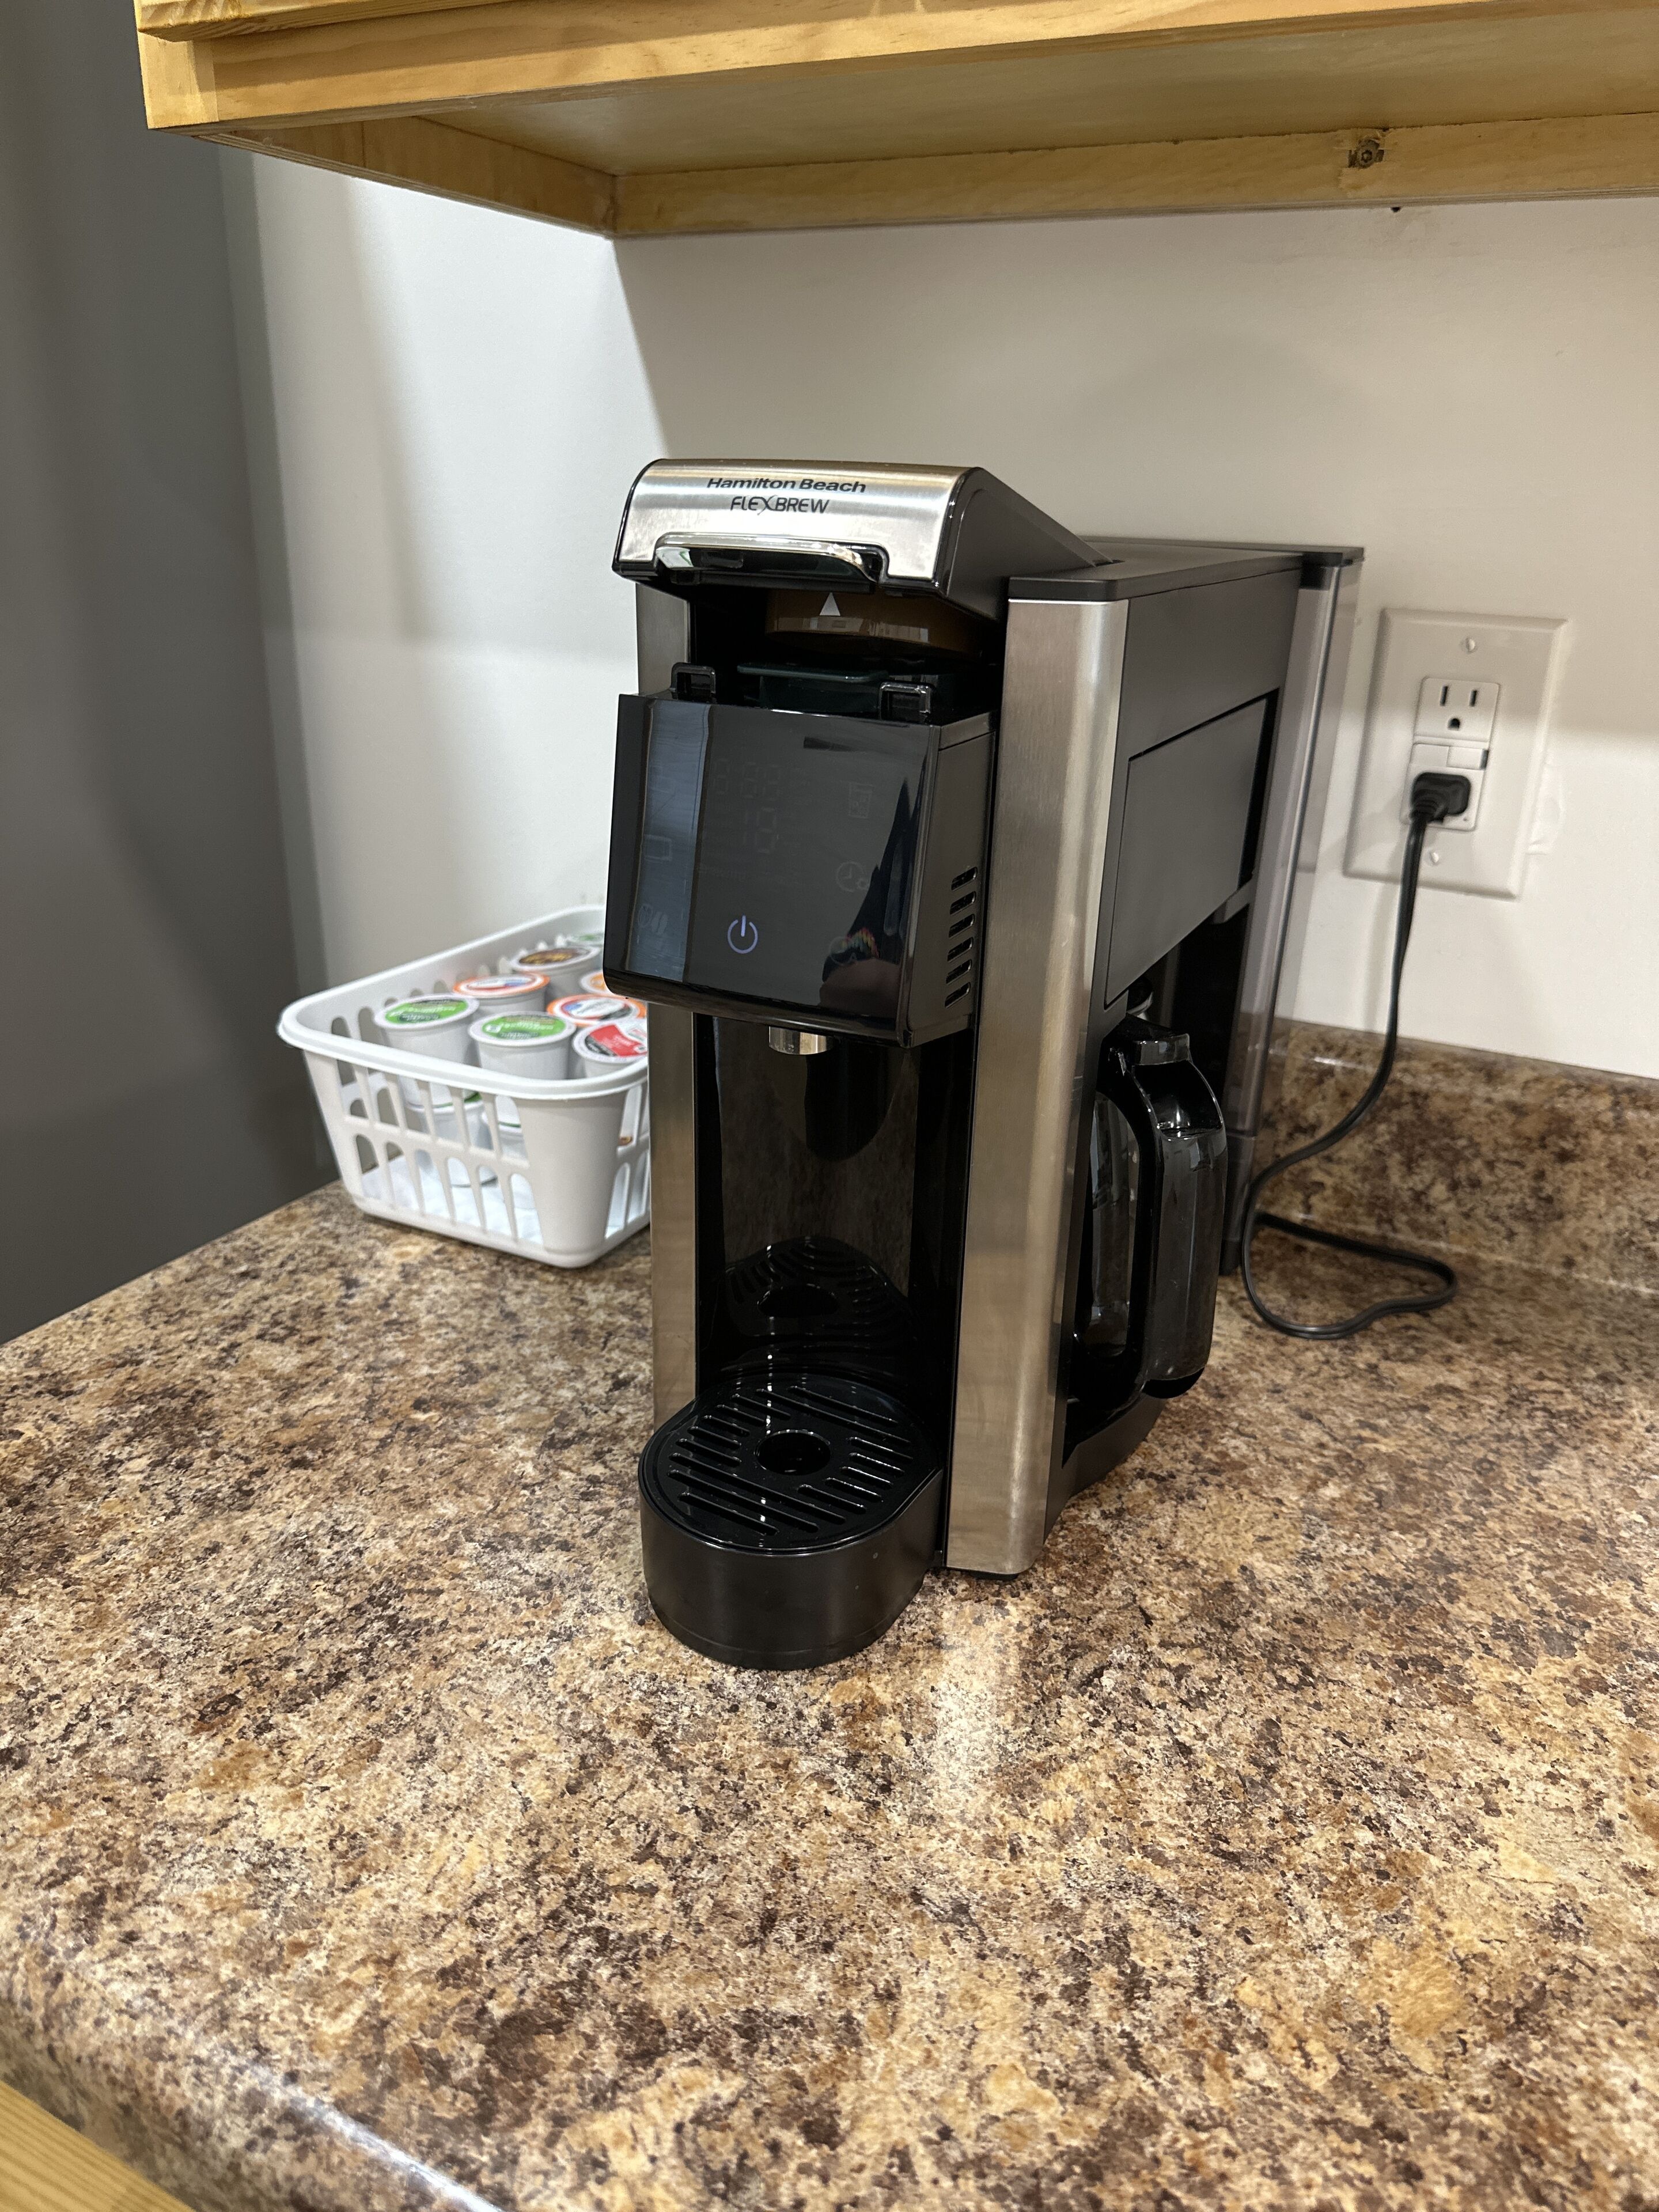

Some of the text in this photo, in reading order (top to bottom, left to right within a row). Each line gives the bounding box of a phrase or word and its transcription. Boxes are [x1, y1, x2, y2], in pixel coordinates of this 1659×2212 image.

[707, 478, 866, 493] Hamilton Beach
[730, 495, 830, 515] FLEXBREW
